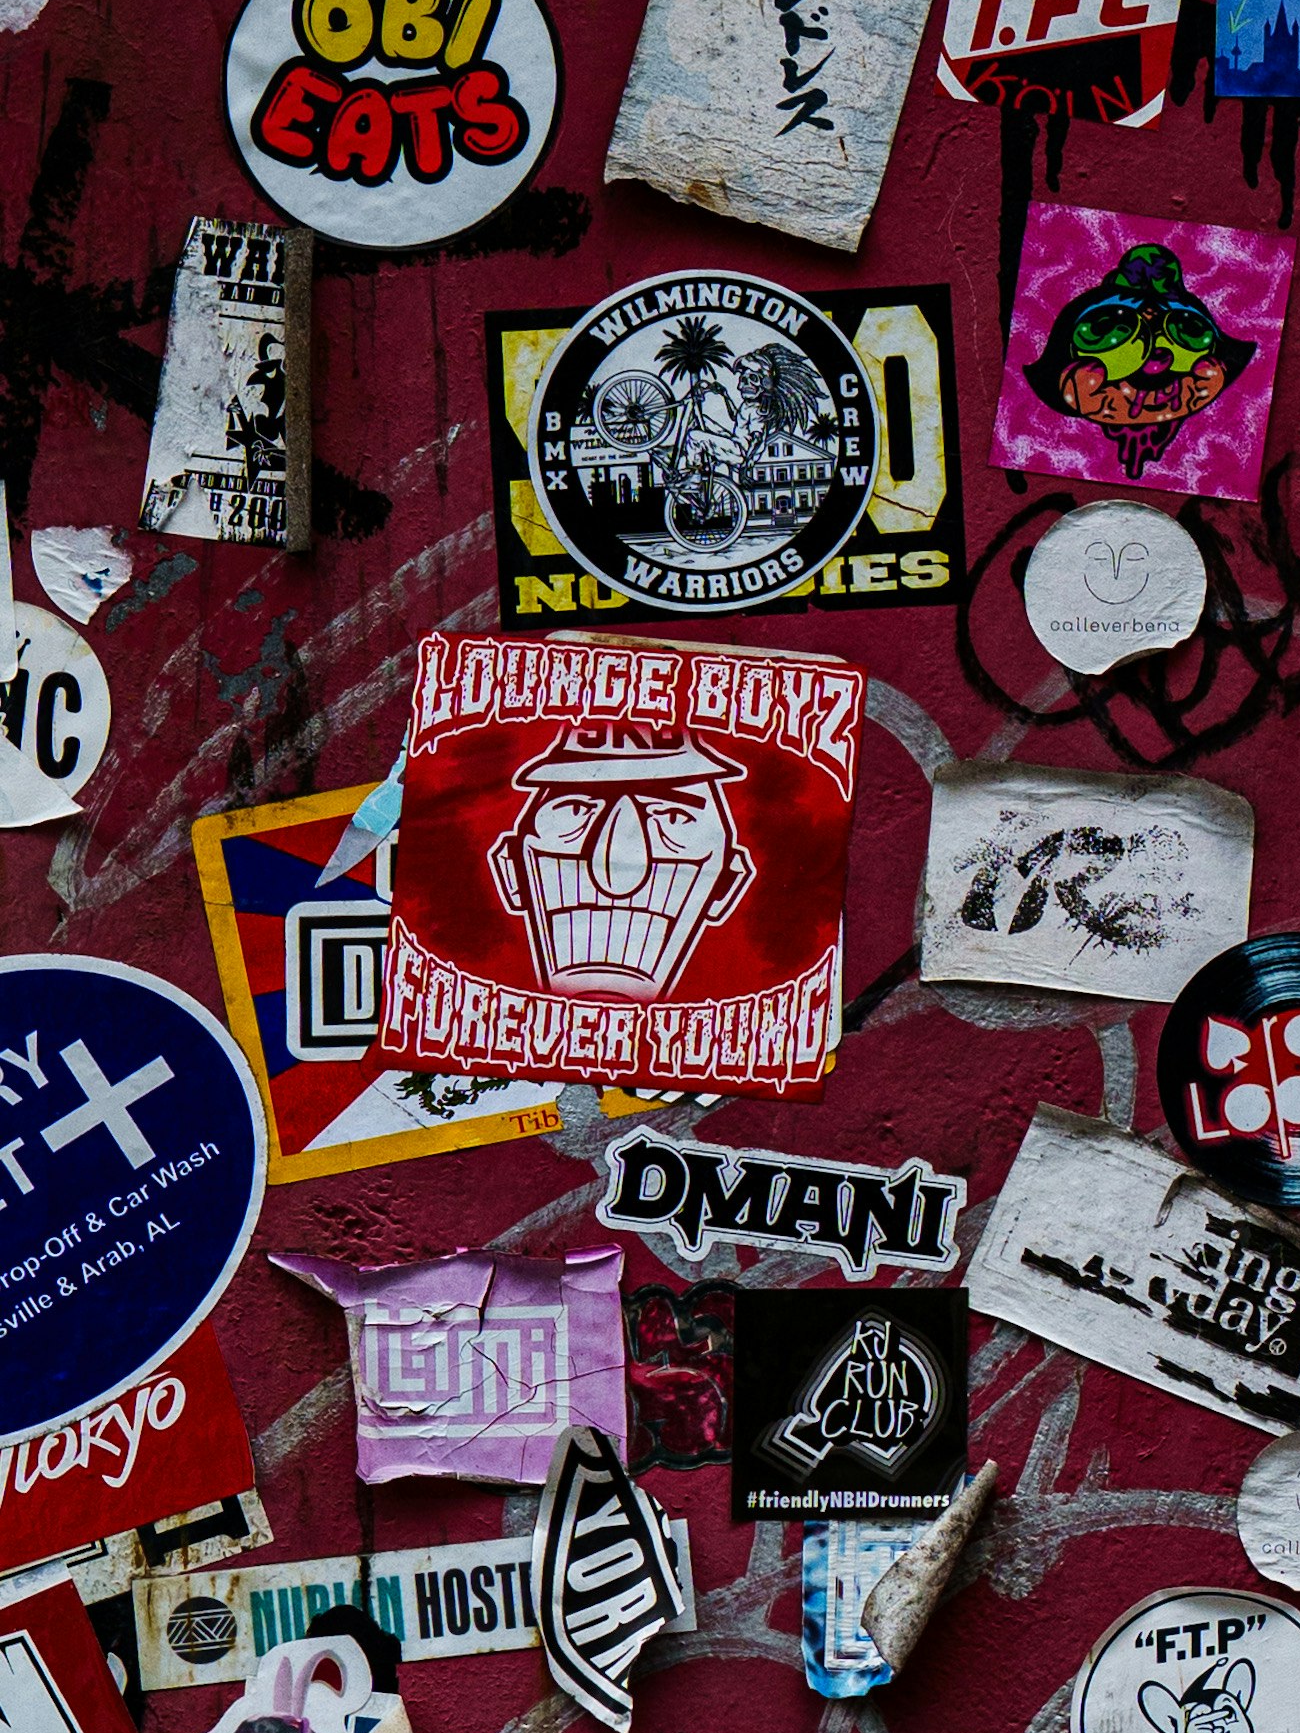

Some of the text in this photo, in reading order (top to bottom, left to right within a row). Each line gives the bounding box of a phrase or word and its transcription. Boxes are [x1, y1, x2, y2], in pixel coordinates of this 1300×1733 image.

[251, 61, 530, 186] EATS
[590, 278, 810, 344] WILMINGTON
[545, 410, 568, 492] BMX
[841, 372, 868, 489] CREW
[624, 549, 805, 602] WARRIORS
[1050, 617, 1181, 636] calleverbena
[411, 633, 862, 801] LOUNGE BOYZ
[382, 919, 838, 1095] FOREVER YOUNG
[108, 1178, 152, 1218] Car
[151, 1137, 221, 1189] Wash
[81, 1239, 146, 1290] Arab,
[143, 1210, 181, 1249] AL
[843, 1360, 909, 1400] RUN
[747, 1490, 951, 1513] #friendlyNBHDrunners
